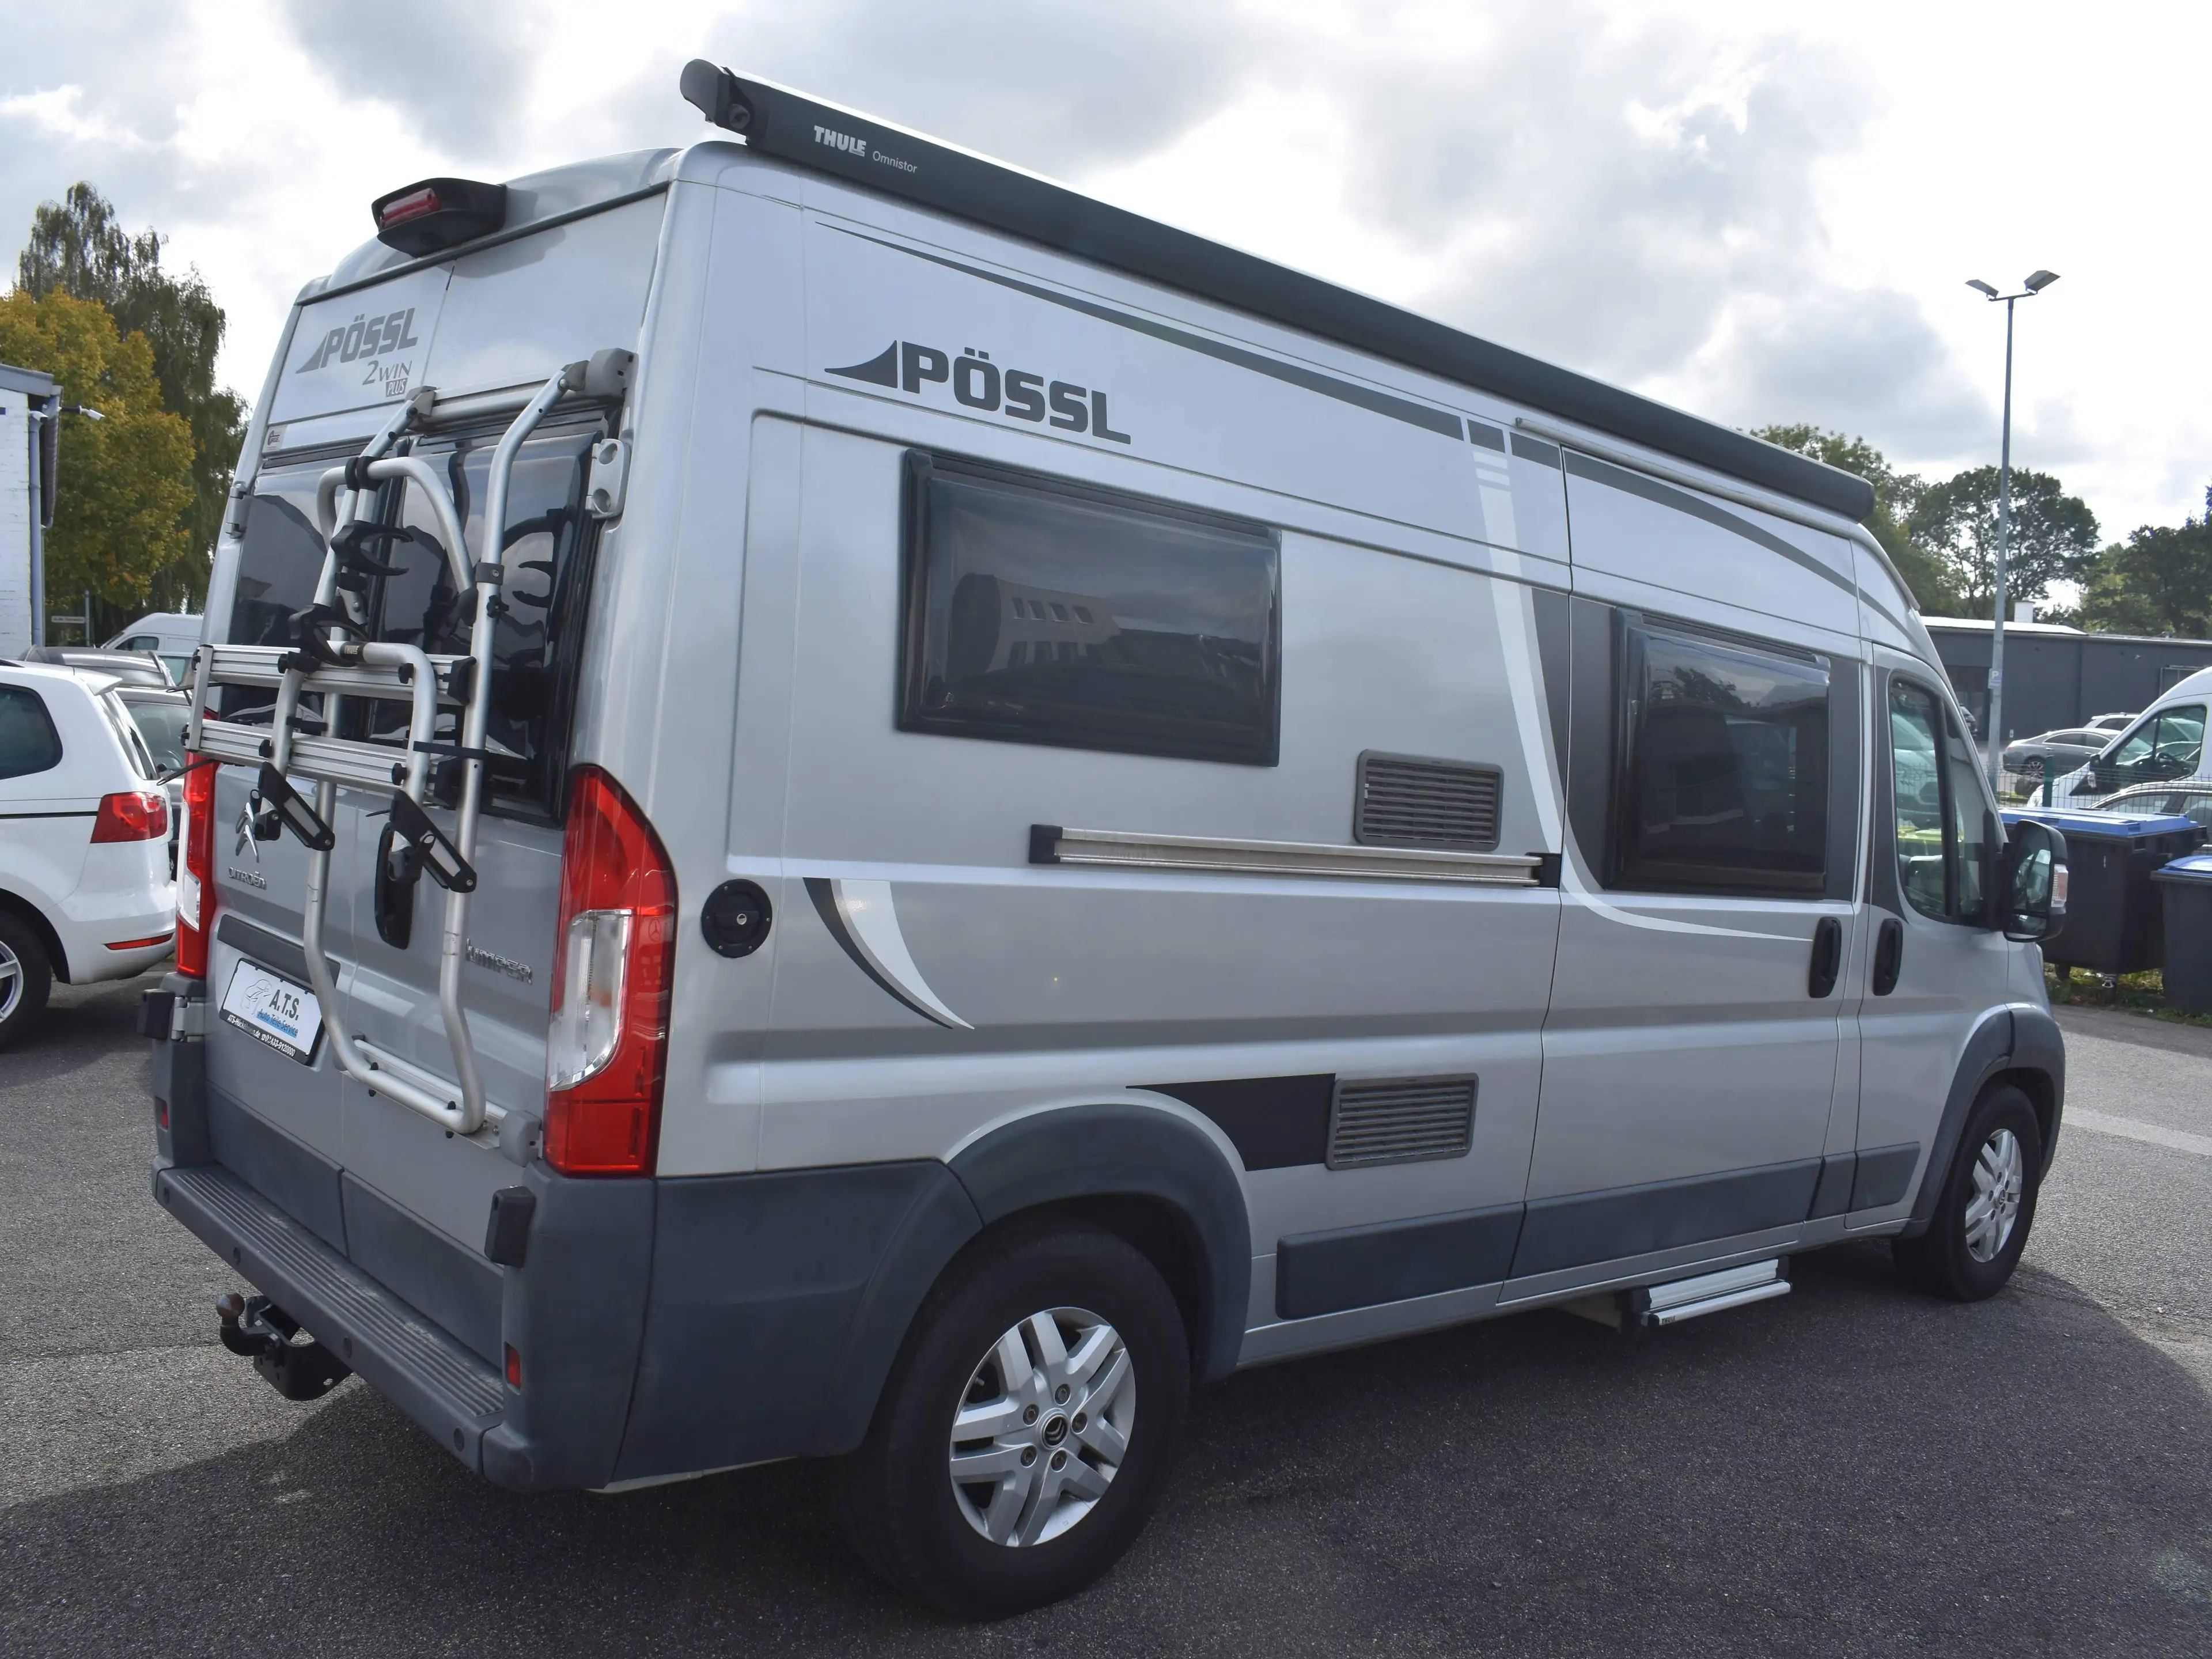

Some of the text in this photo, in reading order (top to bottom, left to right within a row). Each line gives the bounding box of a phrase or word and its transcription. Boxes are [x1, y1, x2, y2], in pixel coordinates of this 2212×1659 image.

[814, 125, 918, 173] THULE Omnistor
[320, 307, 418, 369] PÖSSL
[387, 377, 407, 396] PLUS
[902, 340, 1131, 445] PÖSSL
[1991, 671, 1999, 680] P
[269, 989, 300, 1021] A.T.S.
[227, 1014, 261, 1038] ATS-Hücken.de
[257, 1008, 298, 1037] Auto Teile Service
